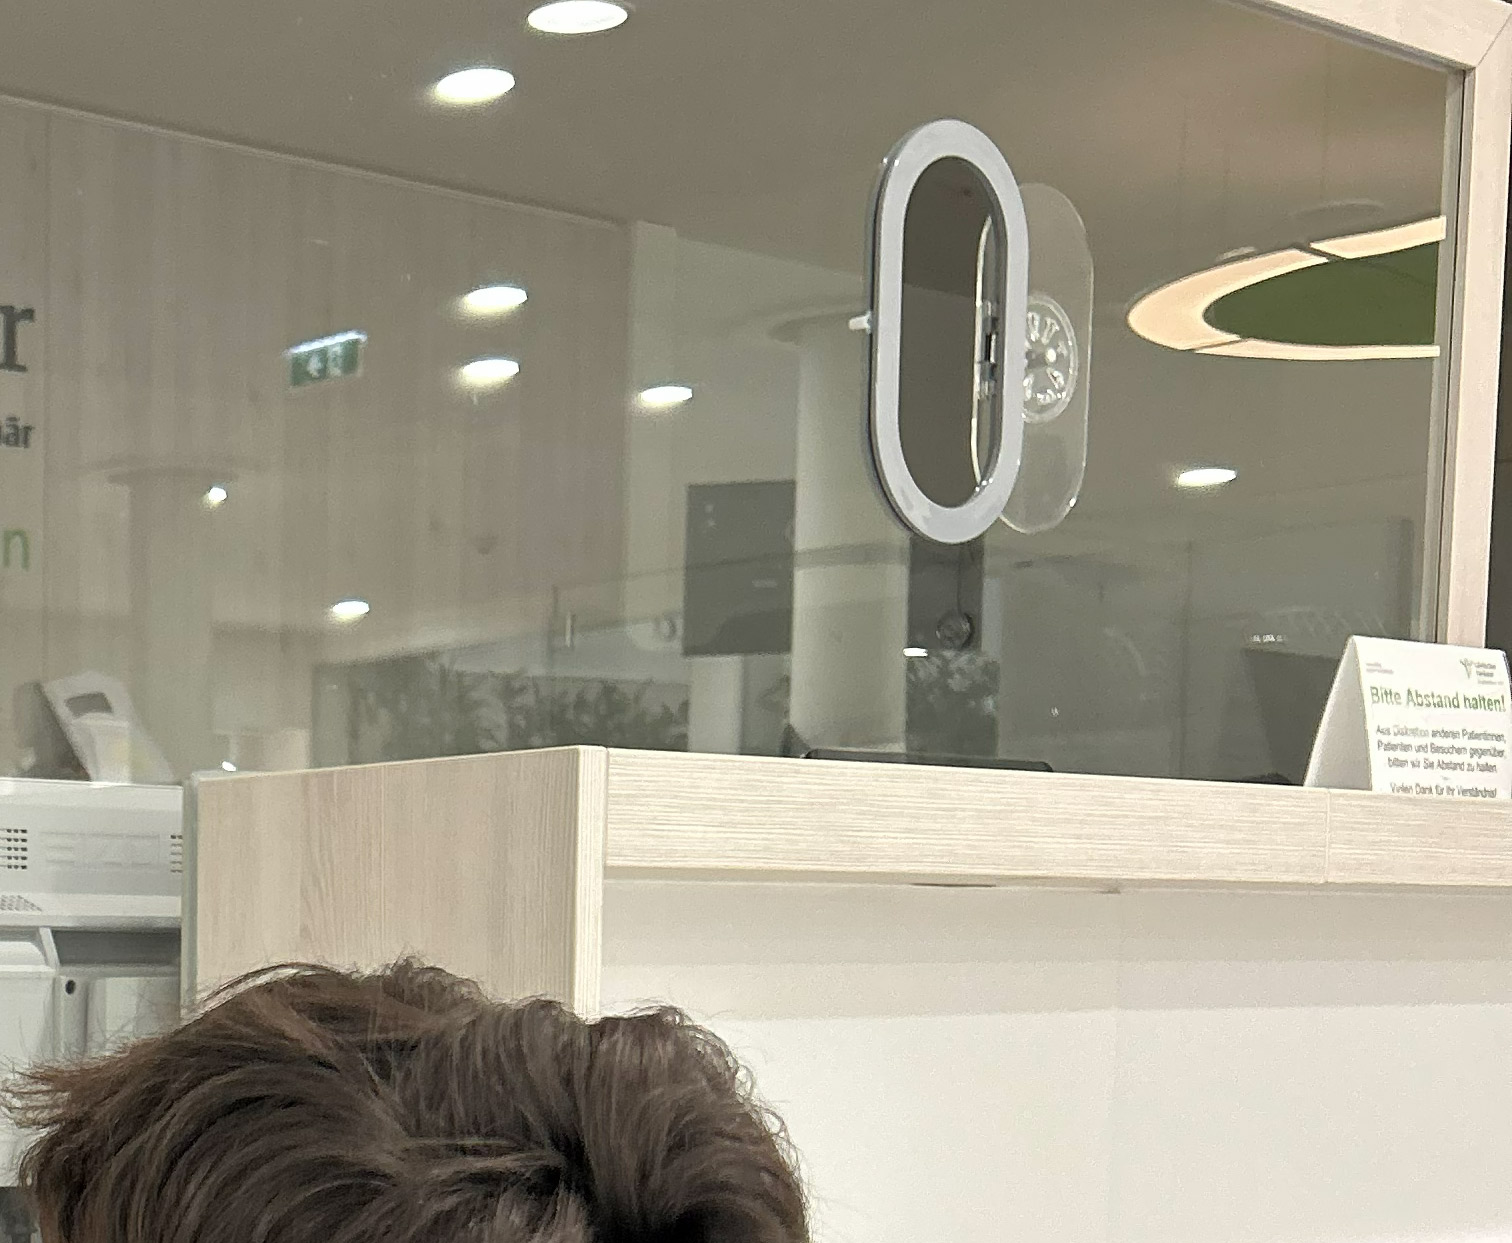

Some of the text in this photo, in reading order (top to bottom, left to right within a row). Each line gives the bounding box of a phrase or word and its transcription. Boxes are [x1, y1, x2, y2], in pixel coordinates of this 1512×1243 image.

[1370, 686, 1506, 713] Bitte Abstand halten!
